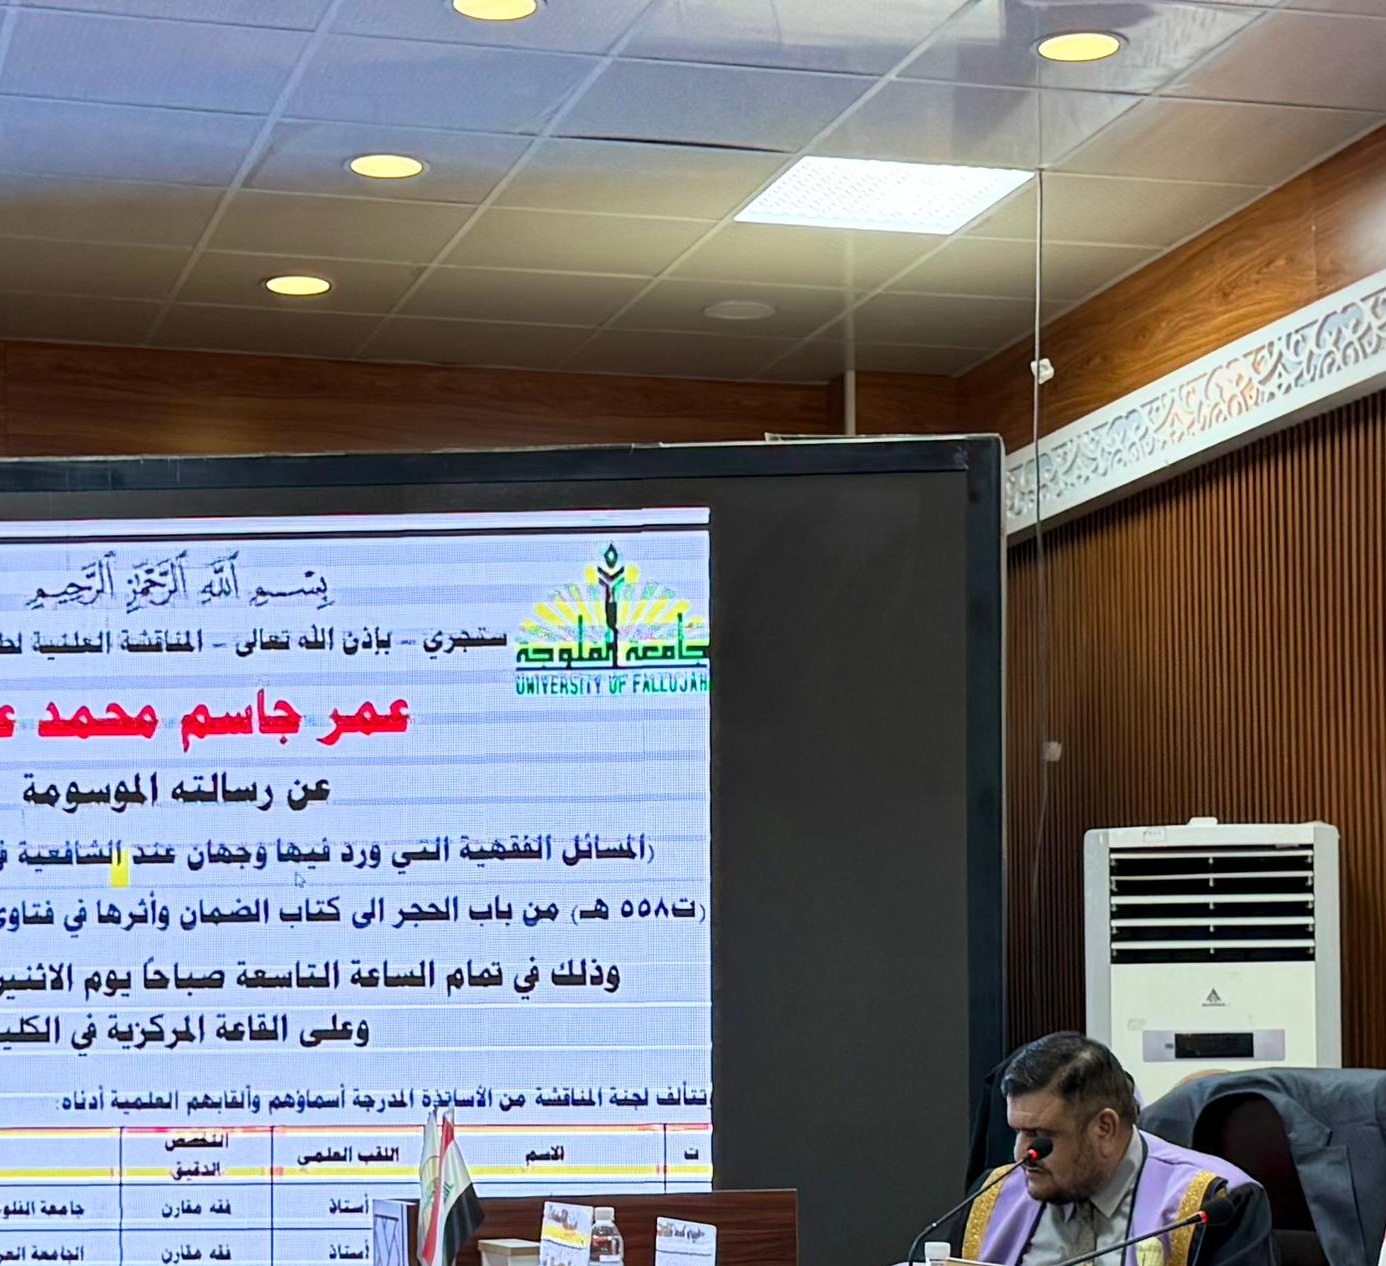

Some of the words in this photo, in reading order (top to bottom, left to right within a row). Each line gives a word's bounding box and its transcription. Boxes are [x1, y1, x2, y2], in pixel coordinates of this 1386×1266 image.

[32, 630, 112, 661] العلنية
[120, 628, 203, 653] المناقشة
[235, 628, 291, 658] تعالى
[297, 623, 334, 651] الله
[342, 626, 391, 656] بإذن
[423, 627, 508, 660] ستجري
[515, 674, 601, 695] UNIVERSITY
[608, 673, 626, 693] OF
[632, 672, 709, 692] FALLUJAH
[38, 701, 158, 739] محمد
[181, 689, 302, 752] جاسم
[316, 701, 410, 745] عمر
[22, 771, 158, 814] الموسومة
[171, 771, 274, 812] رسالته
[286, 779, 331, 811] عن
[18, 839, 122, 873] الشافعية
[132, 842, 176, 865] عند
[187, 839, 268, 872] وجهان
[276, 837, 331, 870] فيها
[340, 843, 382, 870] ورد
[391, 835, 450, 875] التي
[459, 834, 552, 868] الفقهية
[63, 901, 87, 938] في
[96, 890, 170, 932] وأثرها
[180, 898, 269, 931] الضمان
[279, 895, 341, 929] كتاب
[391, 895, 459, 929] الحجر
[468, 894, 513, 927] باب
[522, 903, 560, 927] من
[84, 969, 132, 1002] يوم
[236, 960, 340, 989] التاسعة
[350, 959, 435, 988] الساعة
[446, 959, 503, 998] تمام
[513, 956, 540, 1001] في
[551, 958, 621, 994] وذلك
[70, 1013, 97, 1057] في
[107, 1013, 205, 1050] المركزية
[215, 1013, 288, 1042] القاعة
[299, 1013, 370, 1048] وعلى
[111, 1090, 178, 1115] العلمية
[187, 1085, 260, 1115] وألقابهم
[269, 1084, 344, 1115] أسماؤهم
[352, 1088, 413, 1113] المدرجة
[422, 1086, 492, 1110] الأساتذة
[499, 1094, 525, 1111] من
[536, 1086, 601, 1110] المناقشة
[609, 1087, 648, 1112] لجنة
[656, 1081, 707, 1106] تتألف
[357, 1146, 399, 1165] اللقب
[525, 1145, 564, 1166] الاسم
